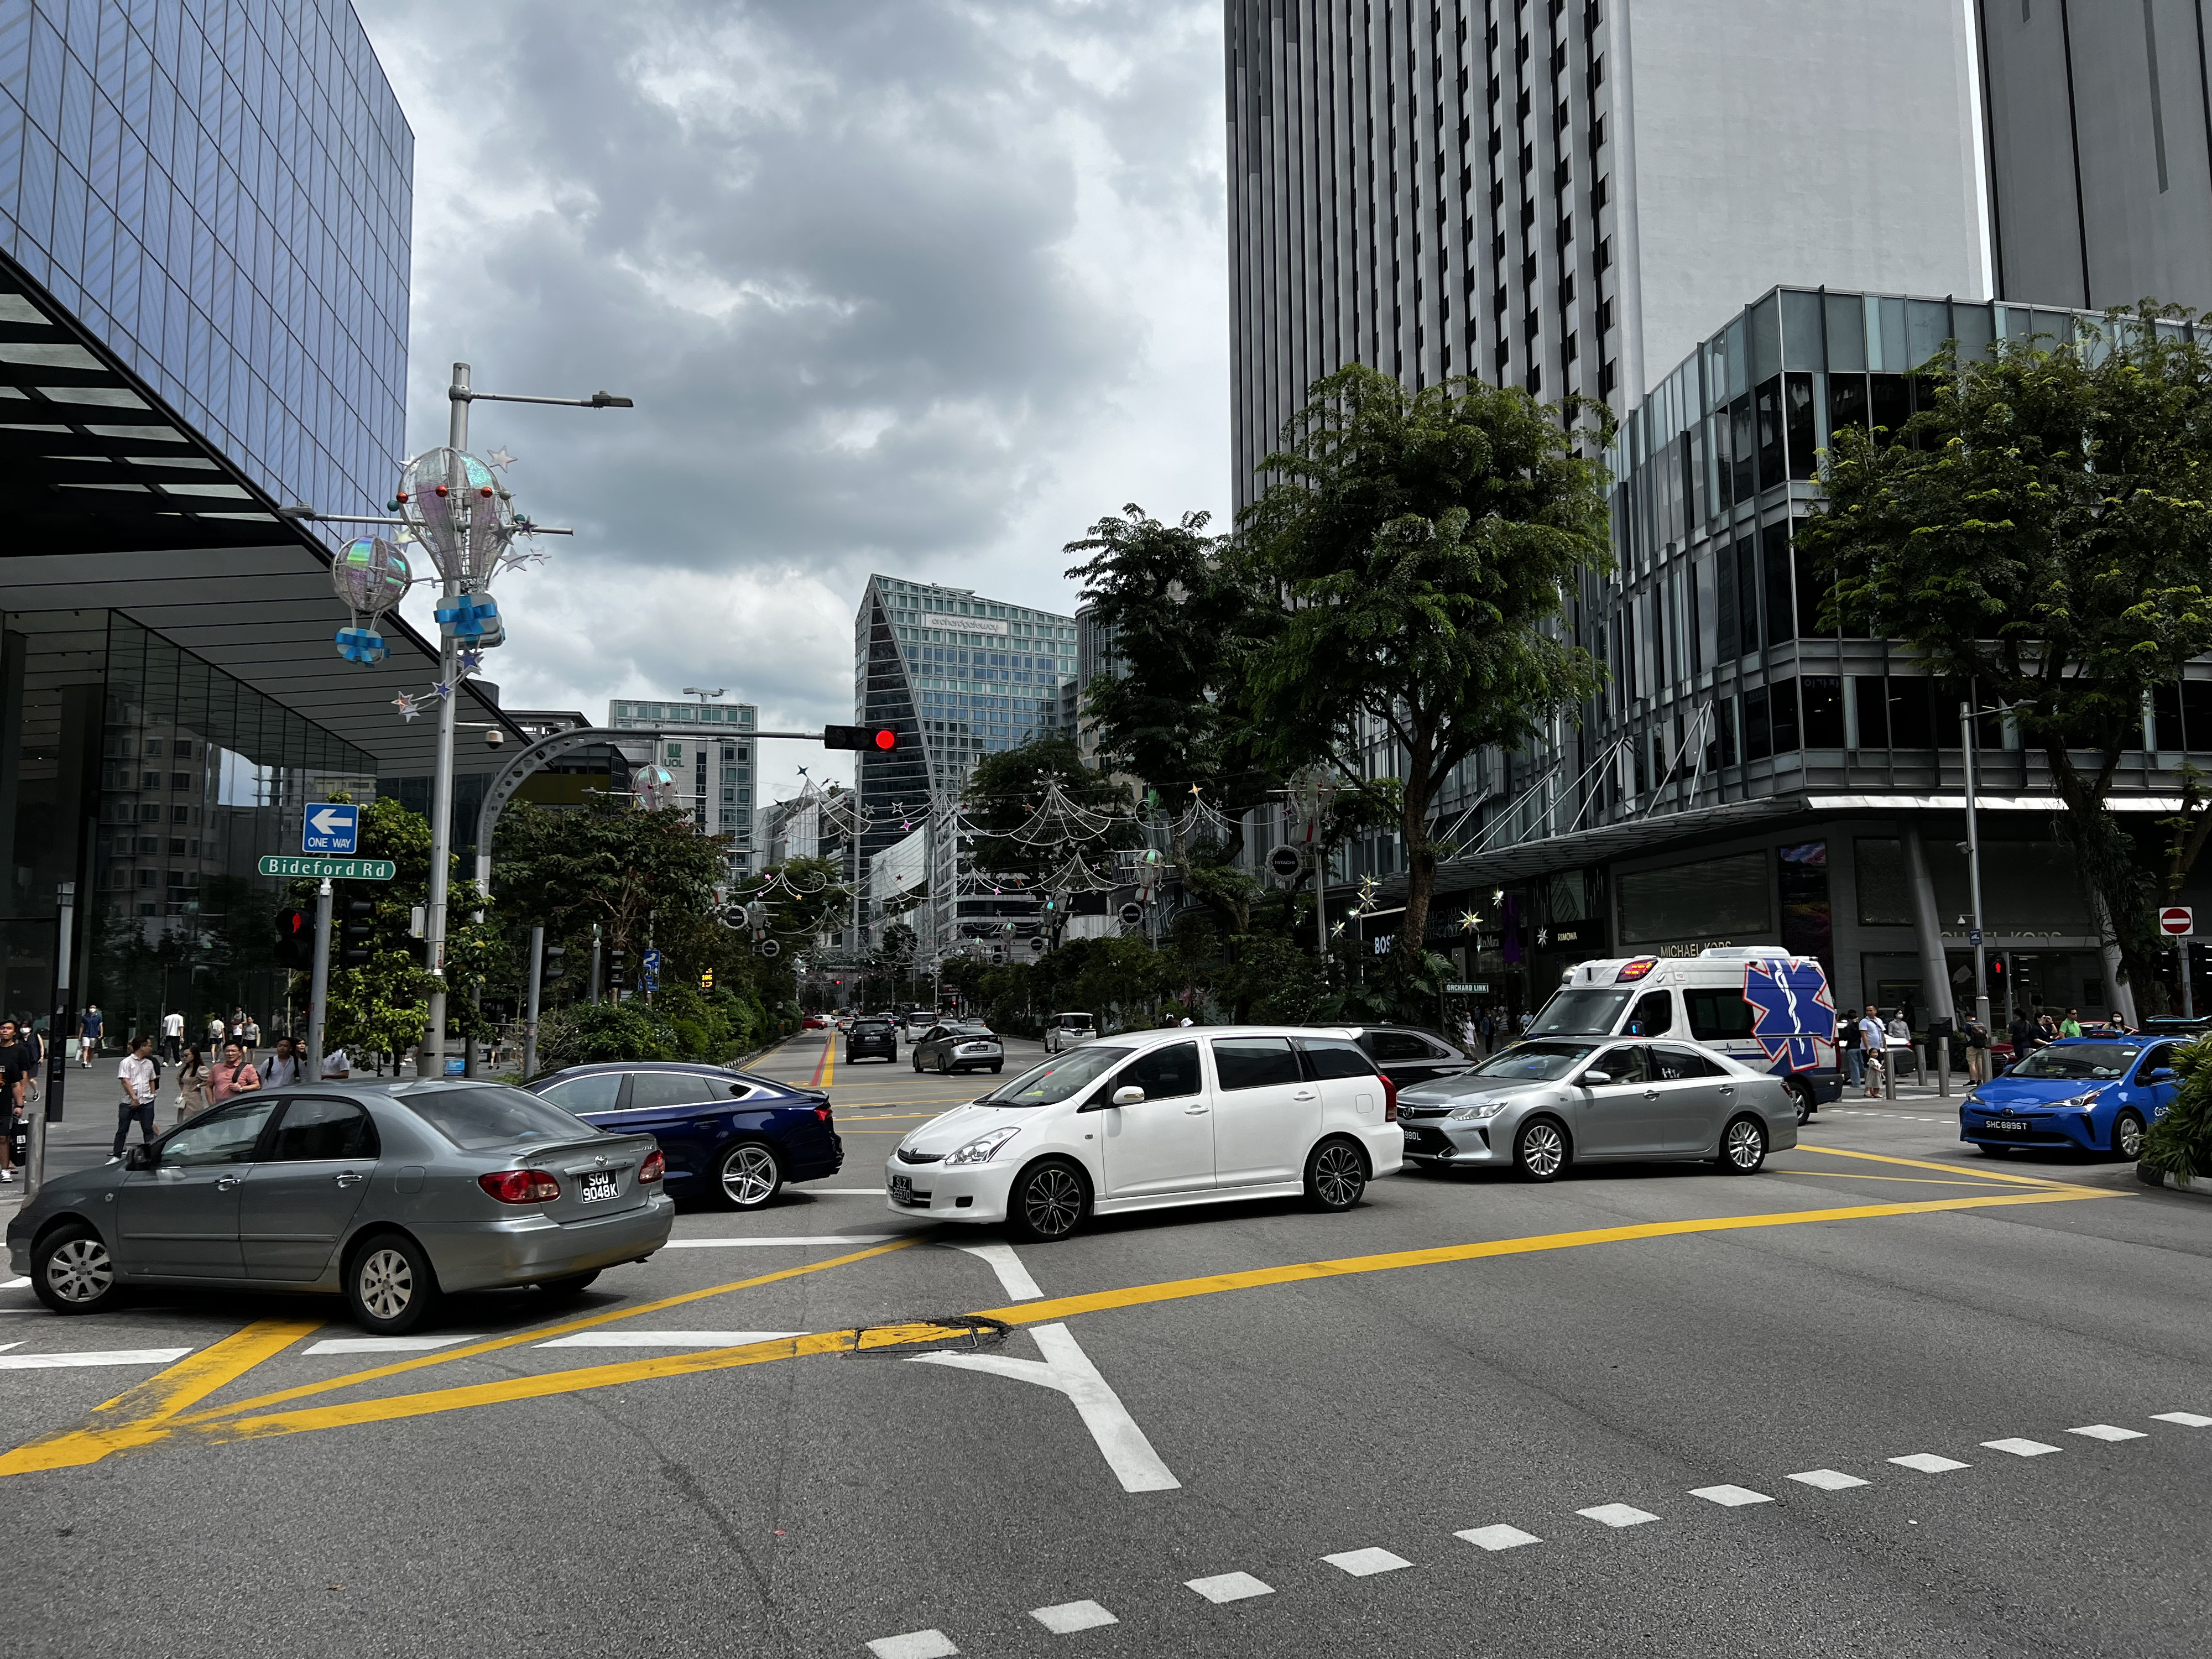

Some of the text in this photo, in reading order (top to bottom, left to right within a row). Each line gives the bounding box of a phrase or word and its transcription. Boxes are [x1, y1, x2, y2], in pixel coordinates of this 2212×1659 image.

[932, 618, 998, 632] orchardgateway
[664, 759, 684, 767] UOL
[308, 837, 352, 848] ONE WAY
[269, 859, 384, 877] Bideford Rd
[1557, 932, 1577, 941] RIMOWA
[1375, 935, 1395, 954] BOS
[1661, 943, 1700, 957] MICHAEL
[1986, 1120, 2027, 1130] SHC8896T
[588, 1171, 609, 1186] SGU
[583, 1183, 618, 1201] 9048K
